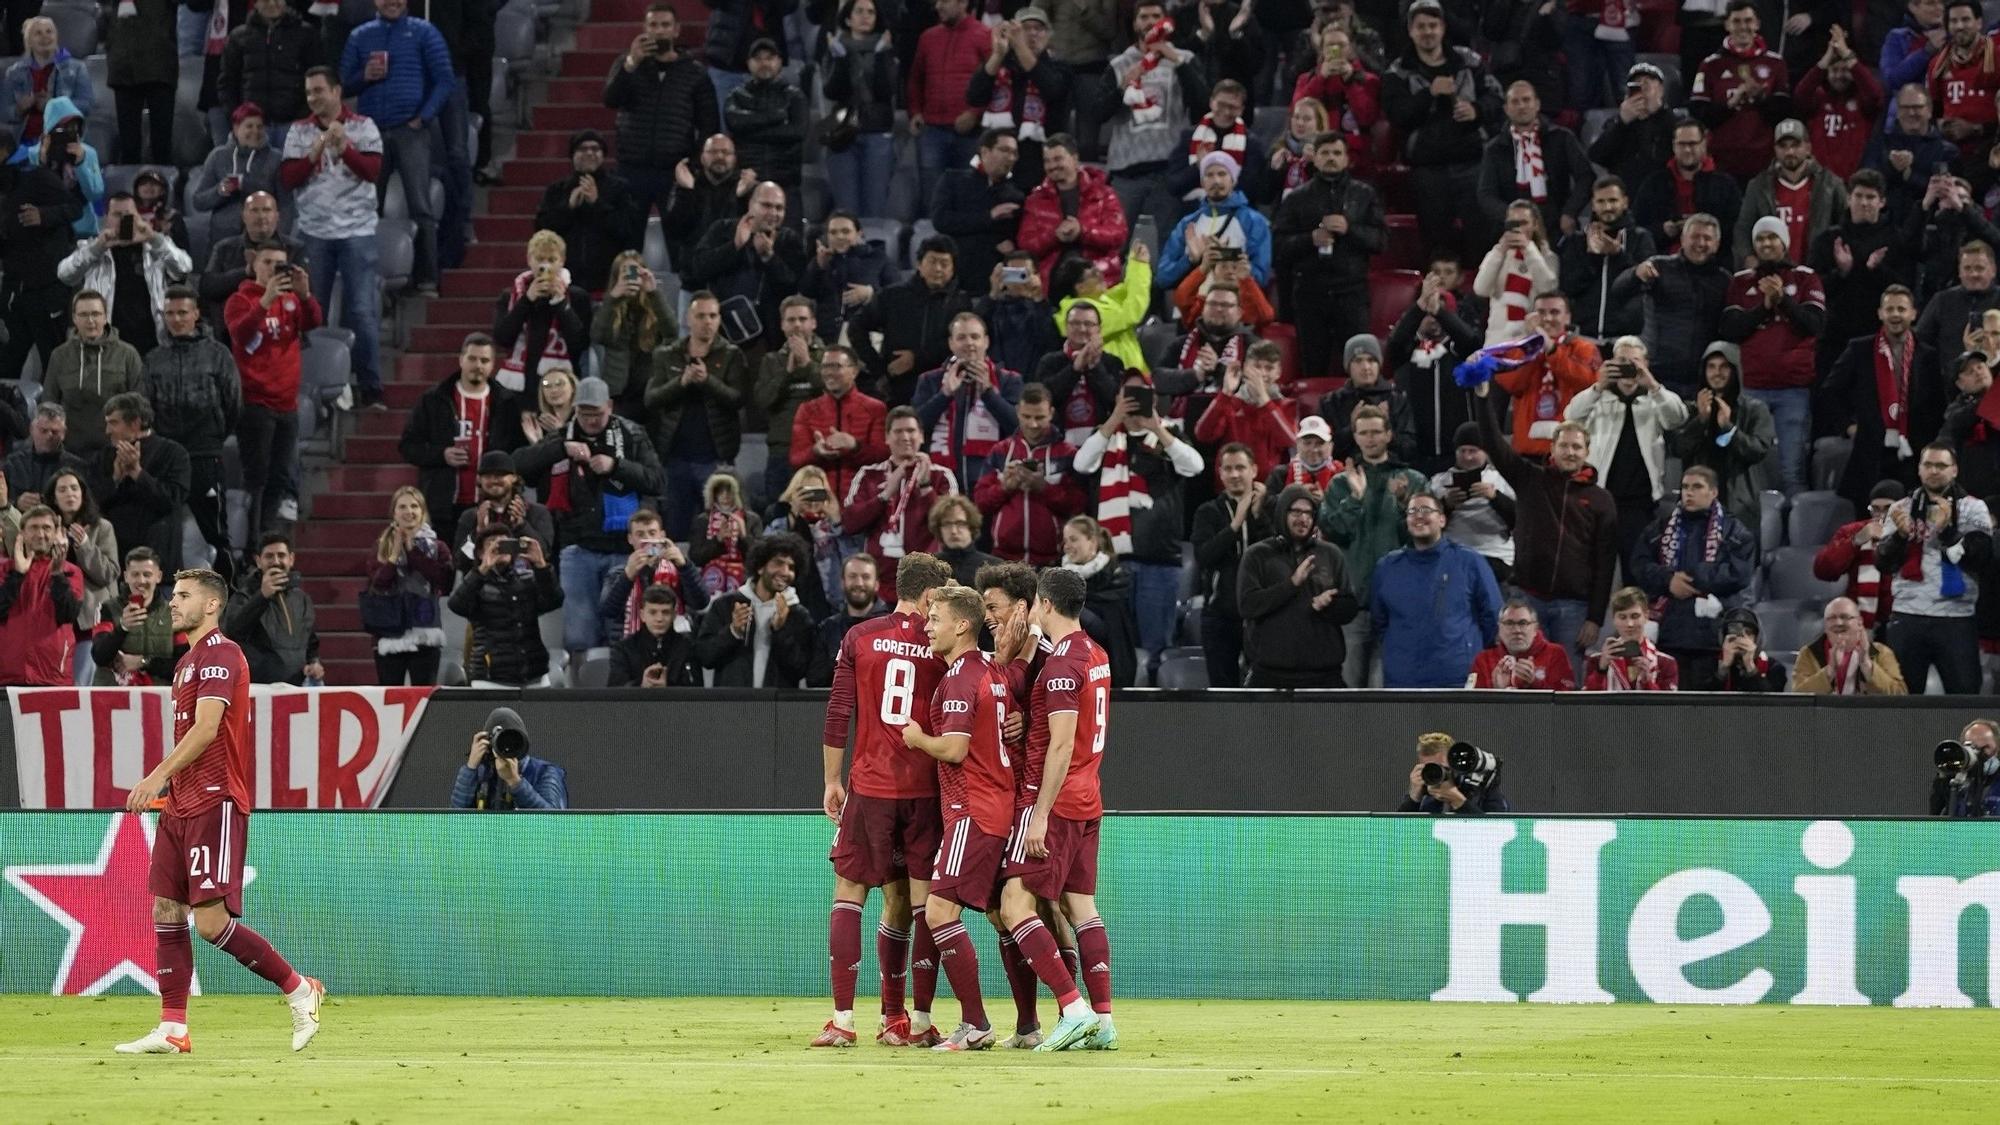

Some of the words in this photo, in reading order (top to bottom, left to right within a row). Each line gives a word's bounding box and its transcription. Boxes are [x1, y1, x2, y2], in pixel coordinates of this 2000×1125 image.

[873, 638, 934, 660] GORETZKA
[880, 658, 916, 726] 8
[1092, 686, 1107, 754] 9
[189, 845, 211, 876] 21
[1430, 820, 2000, 1008] Hein
